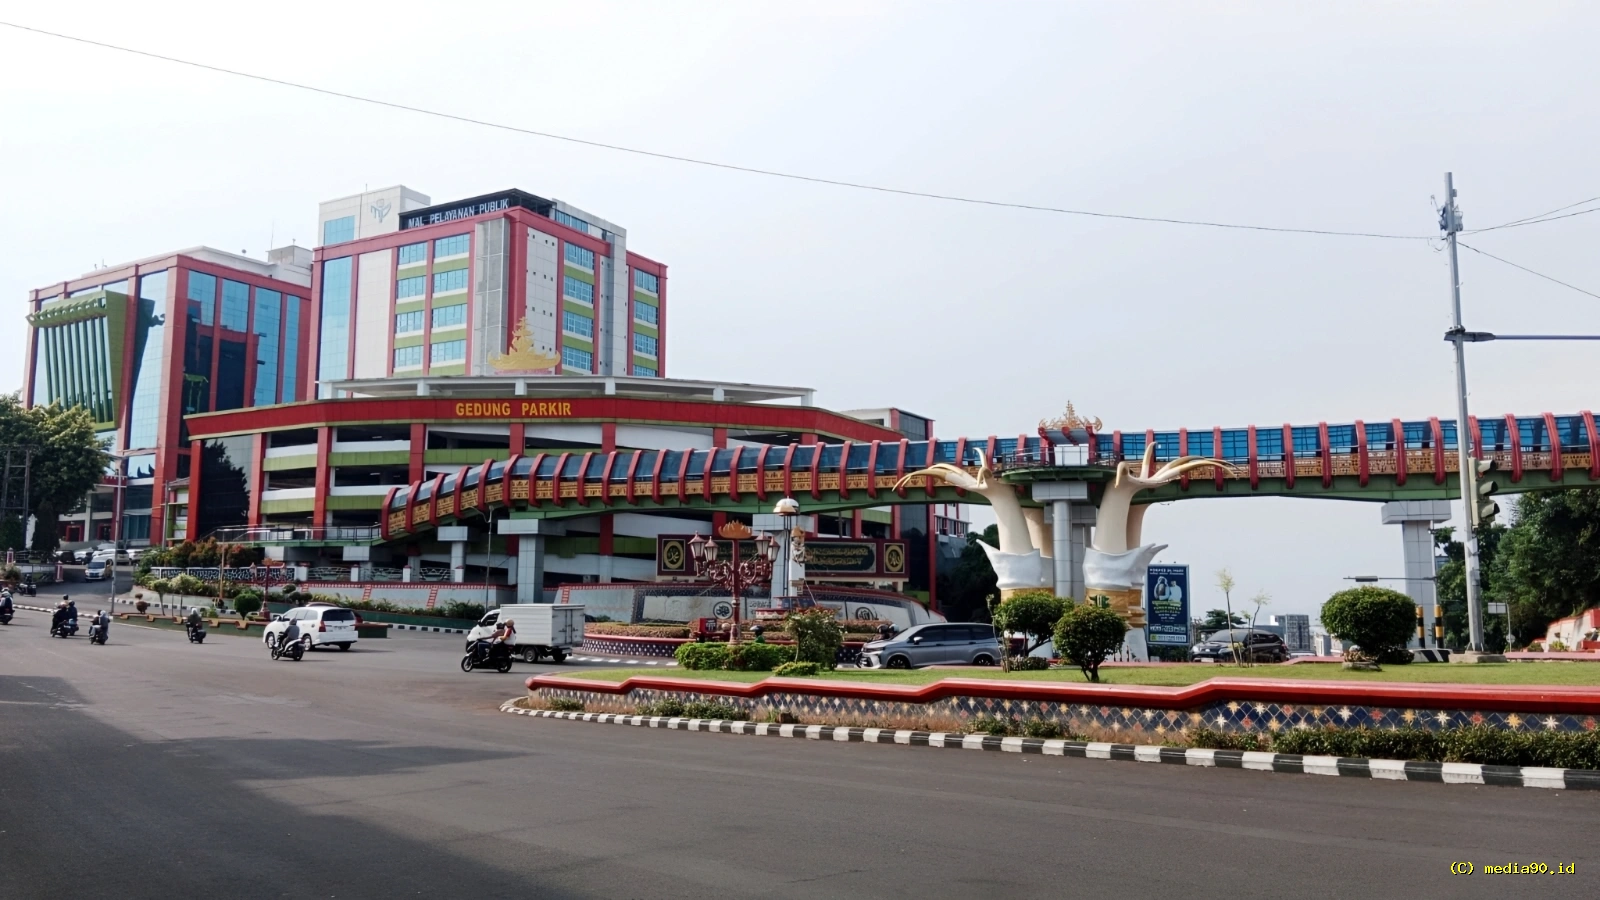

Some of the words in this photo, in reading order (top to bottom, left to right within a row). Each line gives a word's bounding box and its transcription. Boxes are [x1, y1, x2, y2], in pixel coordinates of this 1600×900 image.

[408, 216, 424, 229] MAL
[430, 205, 475, 224] PELAYANAN
[479, 198, 509, 214] PUBLIK
[455, 402, 511, 416] GEDUNG
[522, 402, 572, 416] PARKIR
